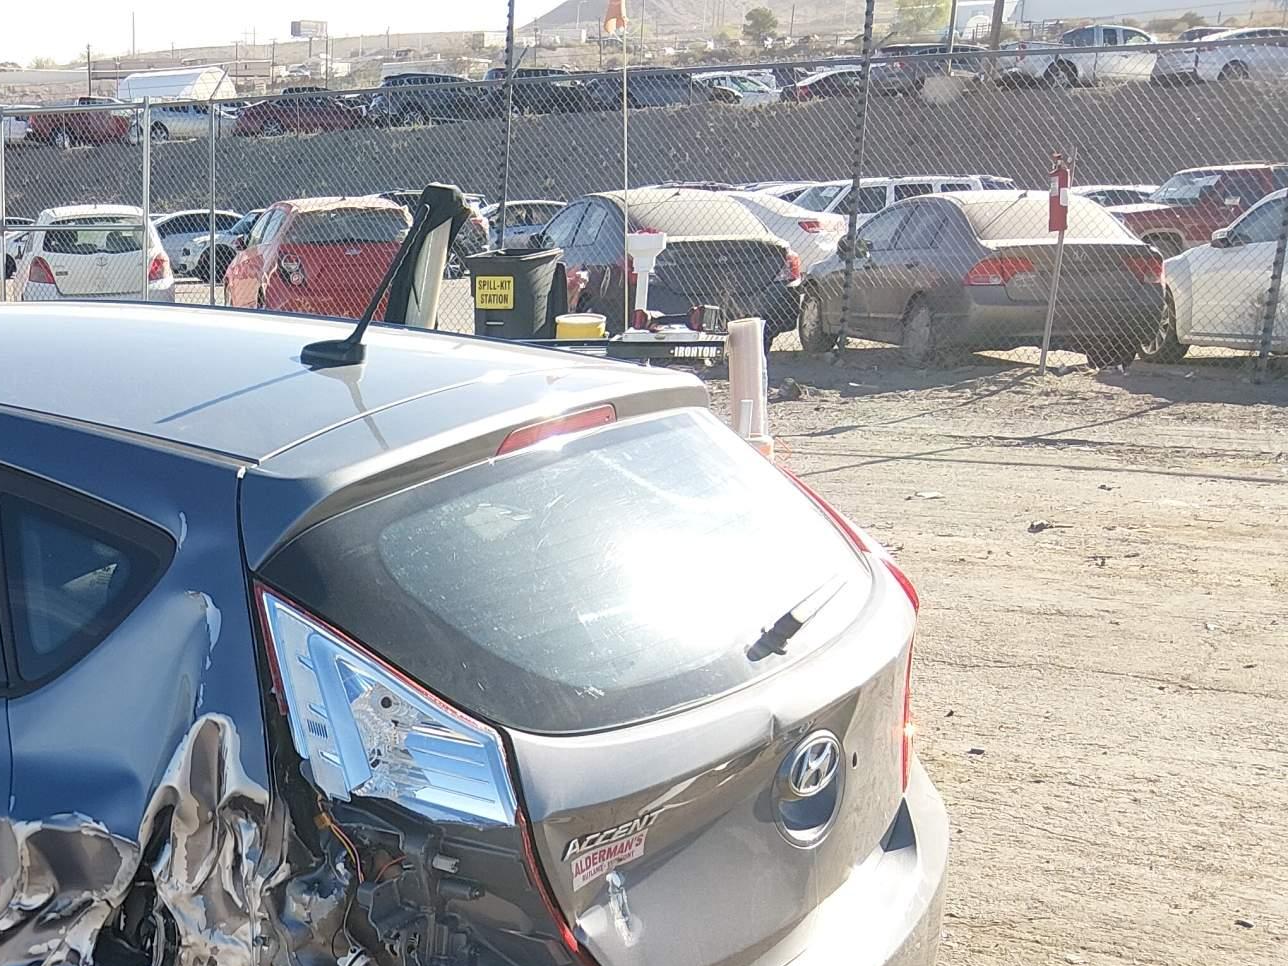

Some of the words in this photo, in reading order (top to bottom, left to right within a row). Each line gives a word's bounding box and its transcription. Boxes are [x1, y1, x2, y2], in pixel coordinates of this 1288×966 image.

[478, 279, 512, 291] SPILL-KIT
[480, 293, 509, 305] STATION
[673, 345, 718, 358] IRONTON
[561, 807, 664, 861] ACCENT
[574, 833, 644, 878] ALDERMAN'S
